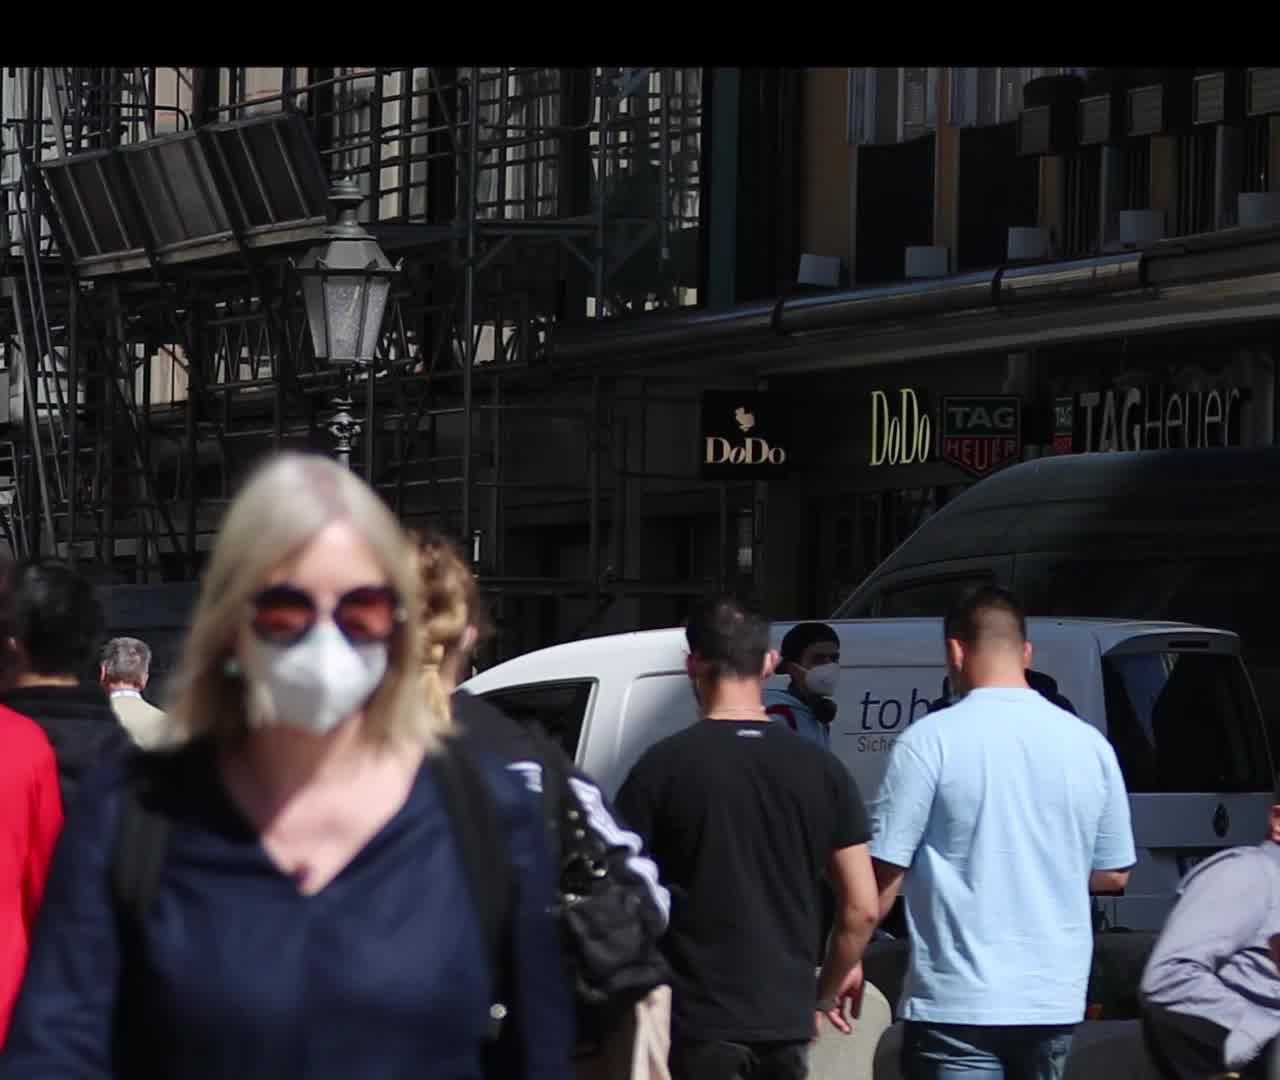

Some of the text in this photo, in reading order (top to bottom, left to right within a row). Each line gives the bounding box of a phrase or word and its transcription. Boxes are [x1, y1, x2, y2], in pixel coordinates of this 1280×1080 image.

[868, 388, 931, 466] DoDo
[947, 406, 1017, 430] TAG
[704, 436, 786, 465] DoDo
